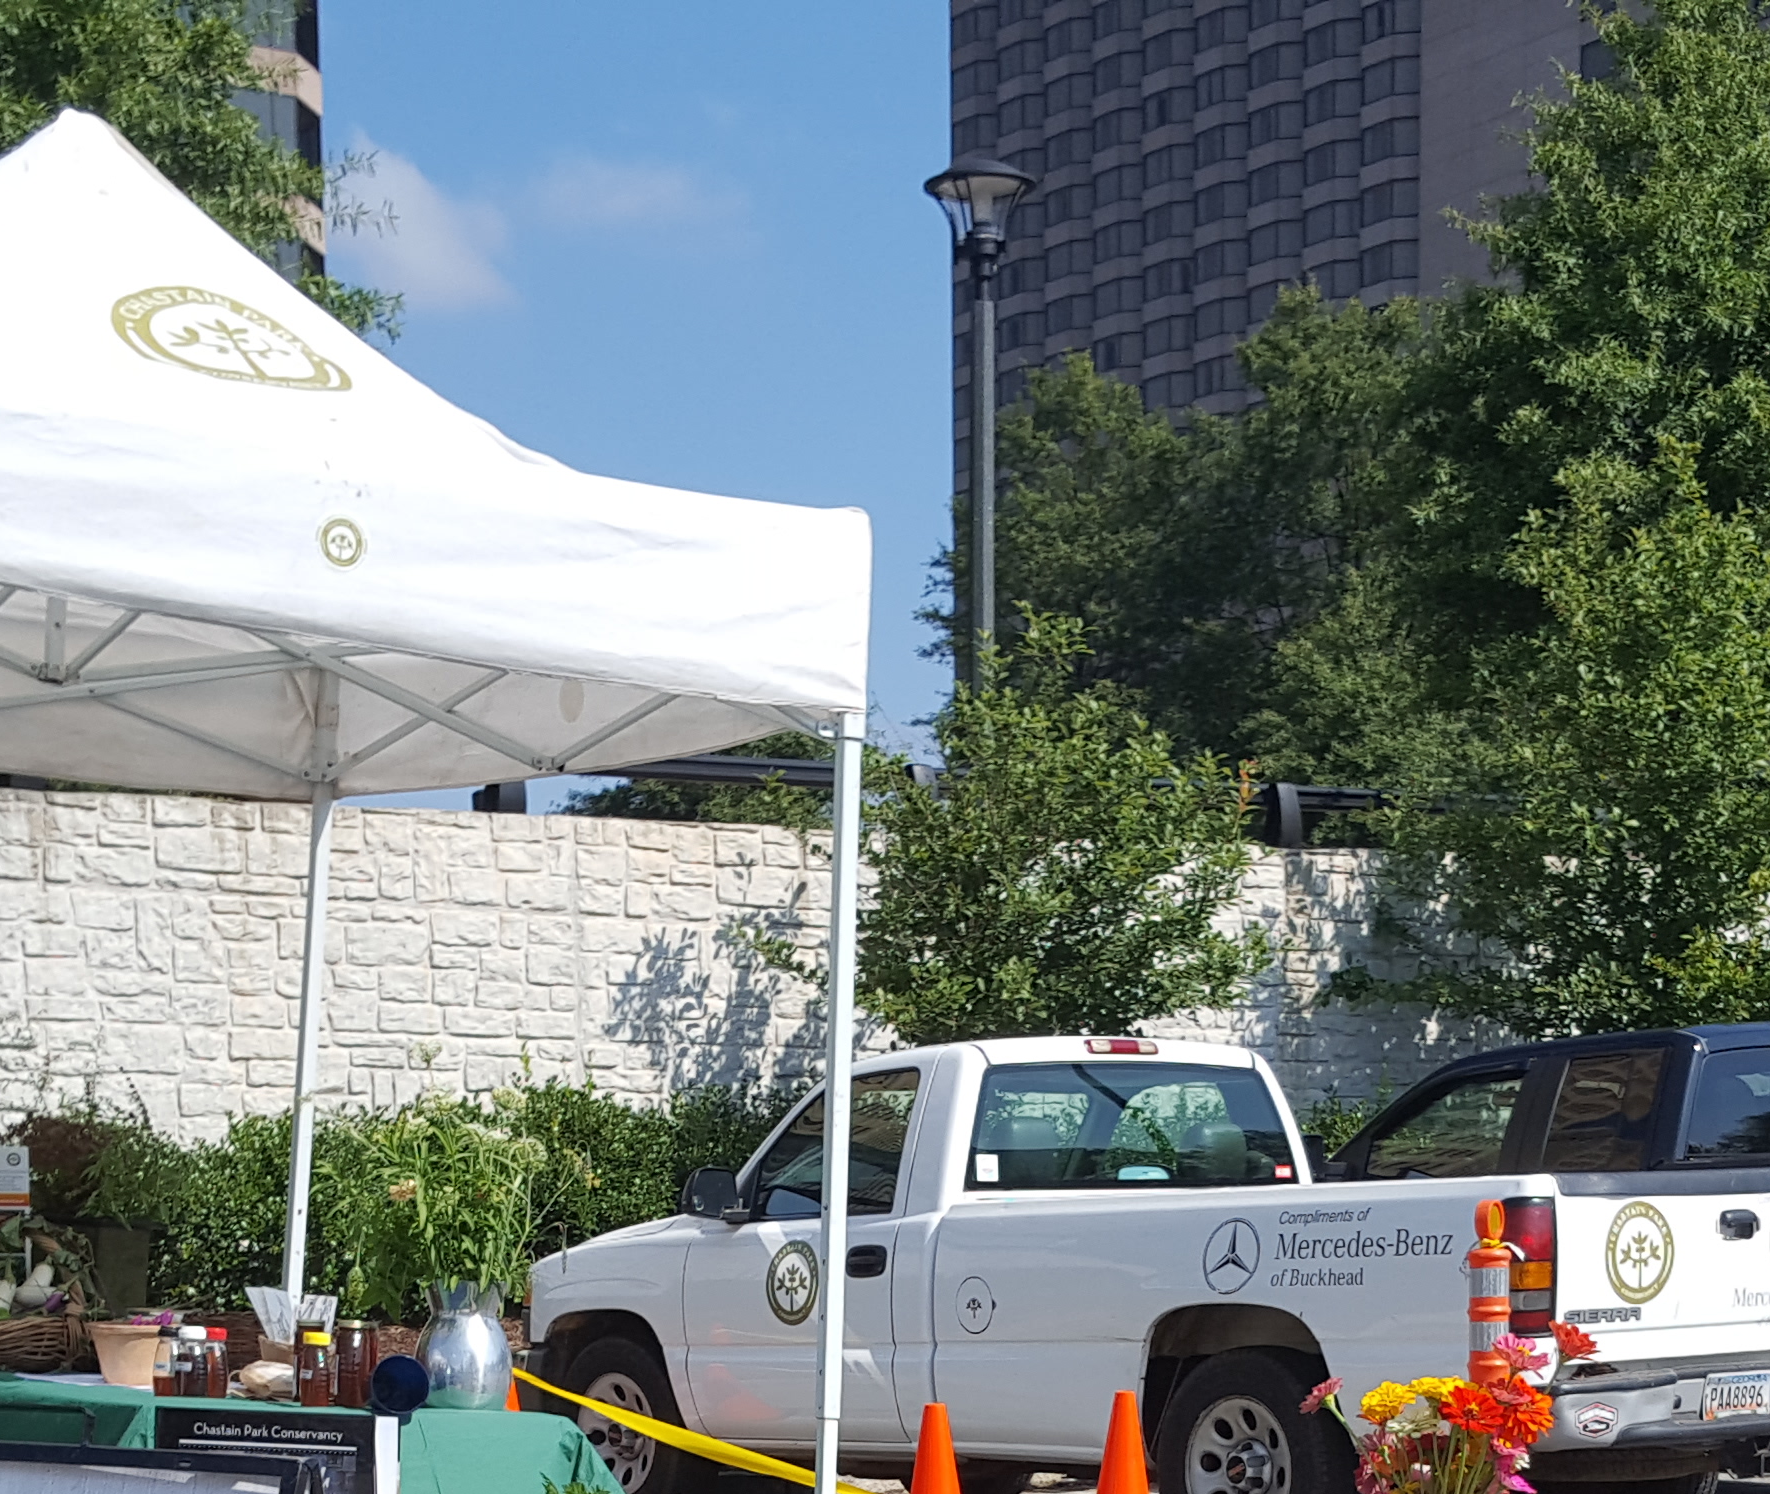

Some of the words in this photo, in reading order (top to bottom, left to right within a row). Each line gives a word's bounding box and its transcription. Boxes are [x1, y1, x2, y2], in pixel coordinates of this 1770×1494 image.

[1279, 1208, 1354, 1226] Compliments
[1357, 1207, 1372, 1221] of
[1274, 1228, 1454, 1260] Mercedes-Benz
[1270, 1268, 1289, 1287] of
[1289, 1267, 1364, 1286] Buckhead
[1564, 1306, 1642, 1324] SIERRA
[1709, 1385, 1764, 1411] PAA8896
[193, 1422, 242, 1436] Chastain
[244, 1424, 268, 1438] Park
[271, 1425, 344, 1443] Conservancy
